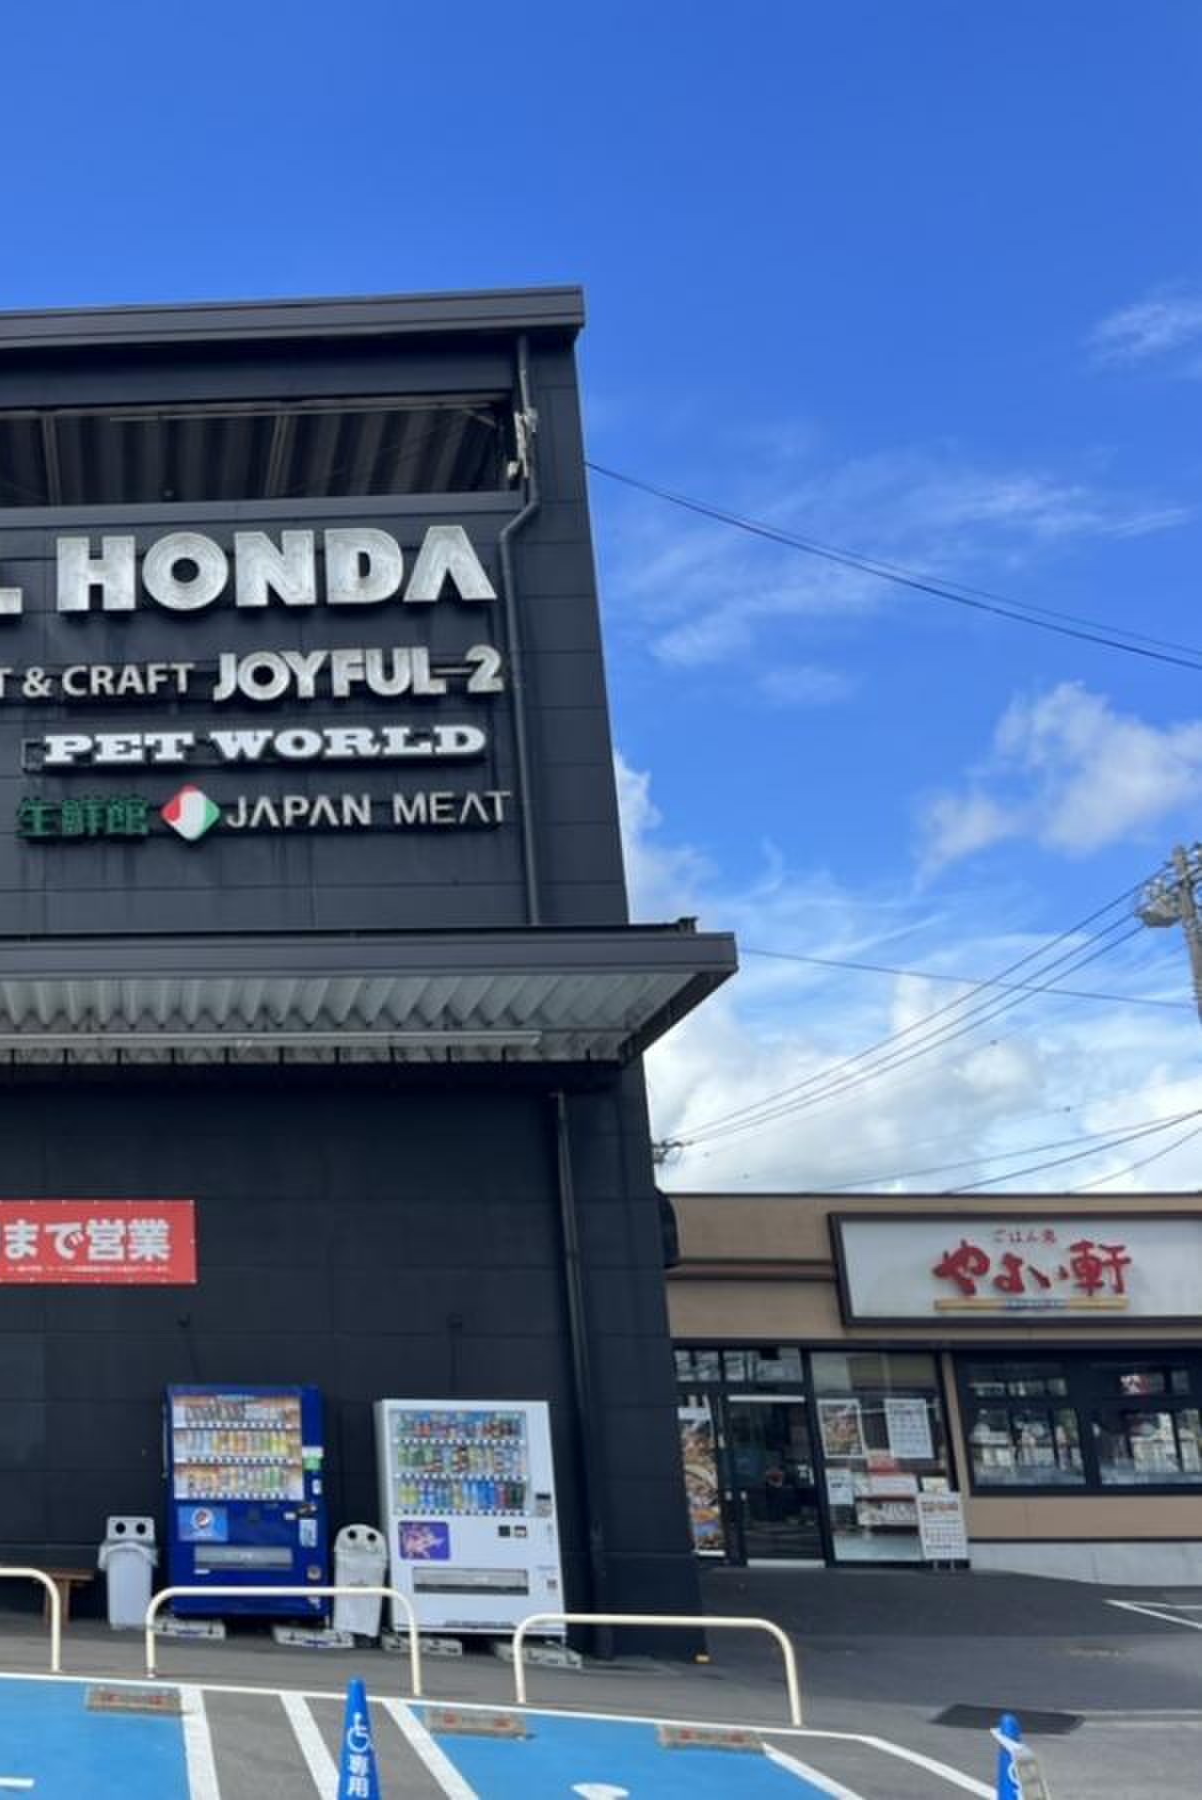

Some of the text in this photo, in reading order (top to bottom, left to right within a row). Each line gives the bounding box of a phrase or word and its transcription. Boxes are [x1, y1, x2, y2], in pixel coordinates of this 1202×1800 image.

[56, 525, 498, 612] HONDA
[21, 666, 52, 698] &
[61, 662, 195, 697] CRAFT
[43, 724, 488, 764] PET WORLD
[15, 793, 150, 839] 生鮮館
[225, 790, 511, 828] JAPAN MEAT
[932, 1238, 1132, 1297] やよい軒
[347, 1753, 369, 1798] 専用
